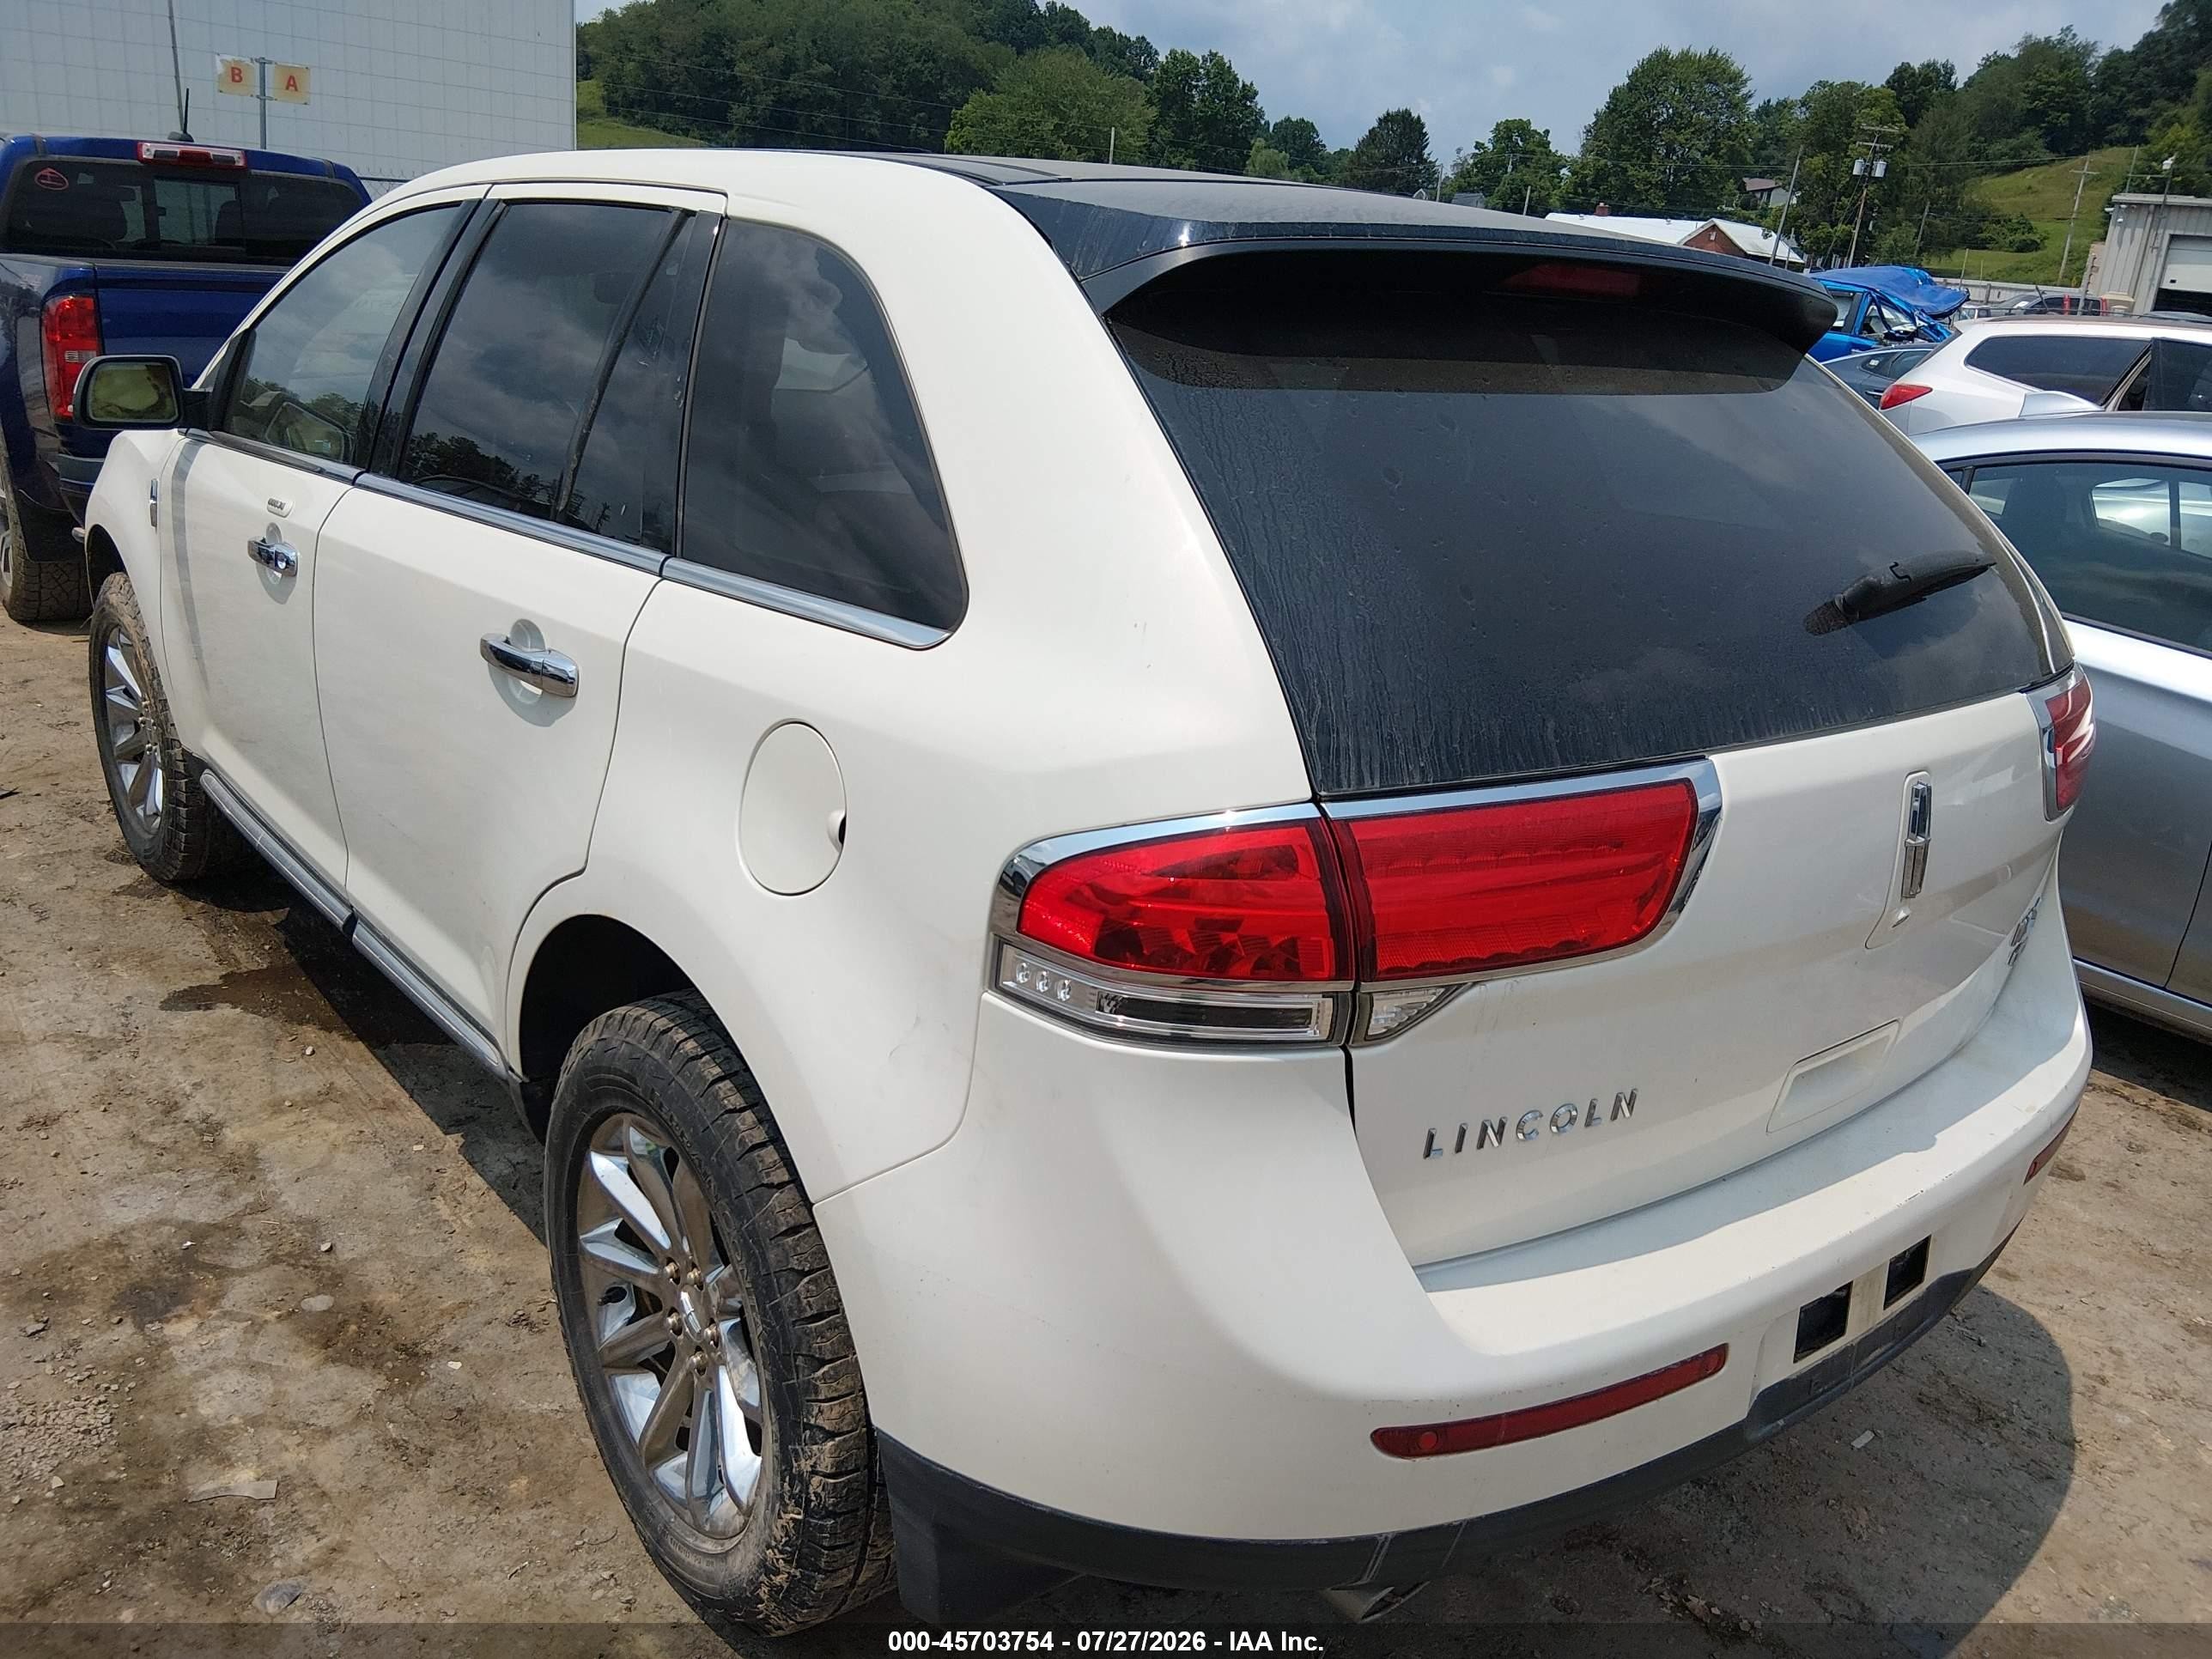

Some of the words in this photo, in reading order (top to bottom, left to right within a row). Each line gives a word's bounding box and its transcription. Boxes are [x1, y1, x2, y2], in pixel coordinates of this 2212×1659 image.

[230, 66, 243, 82] B
[285, 75, 298, 92] A
[1422, 1087, 1639, 1159] LINCOLN
